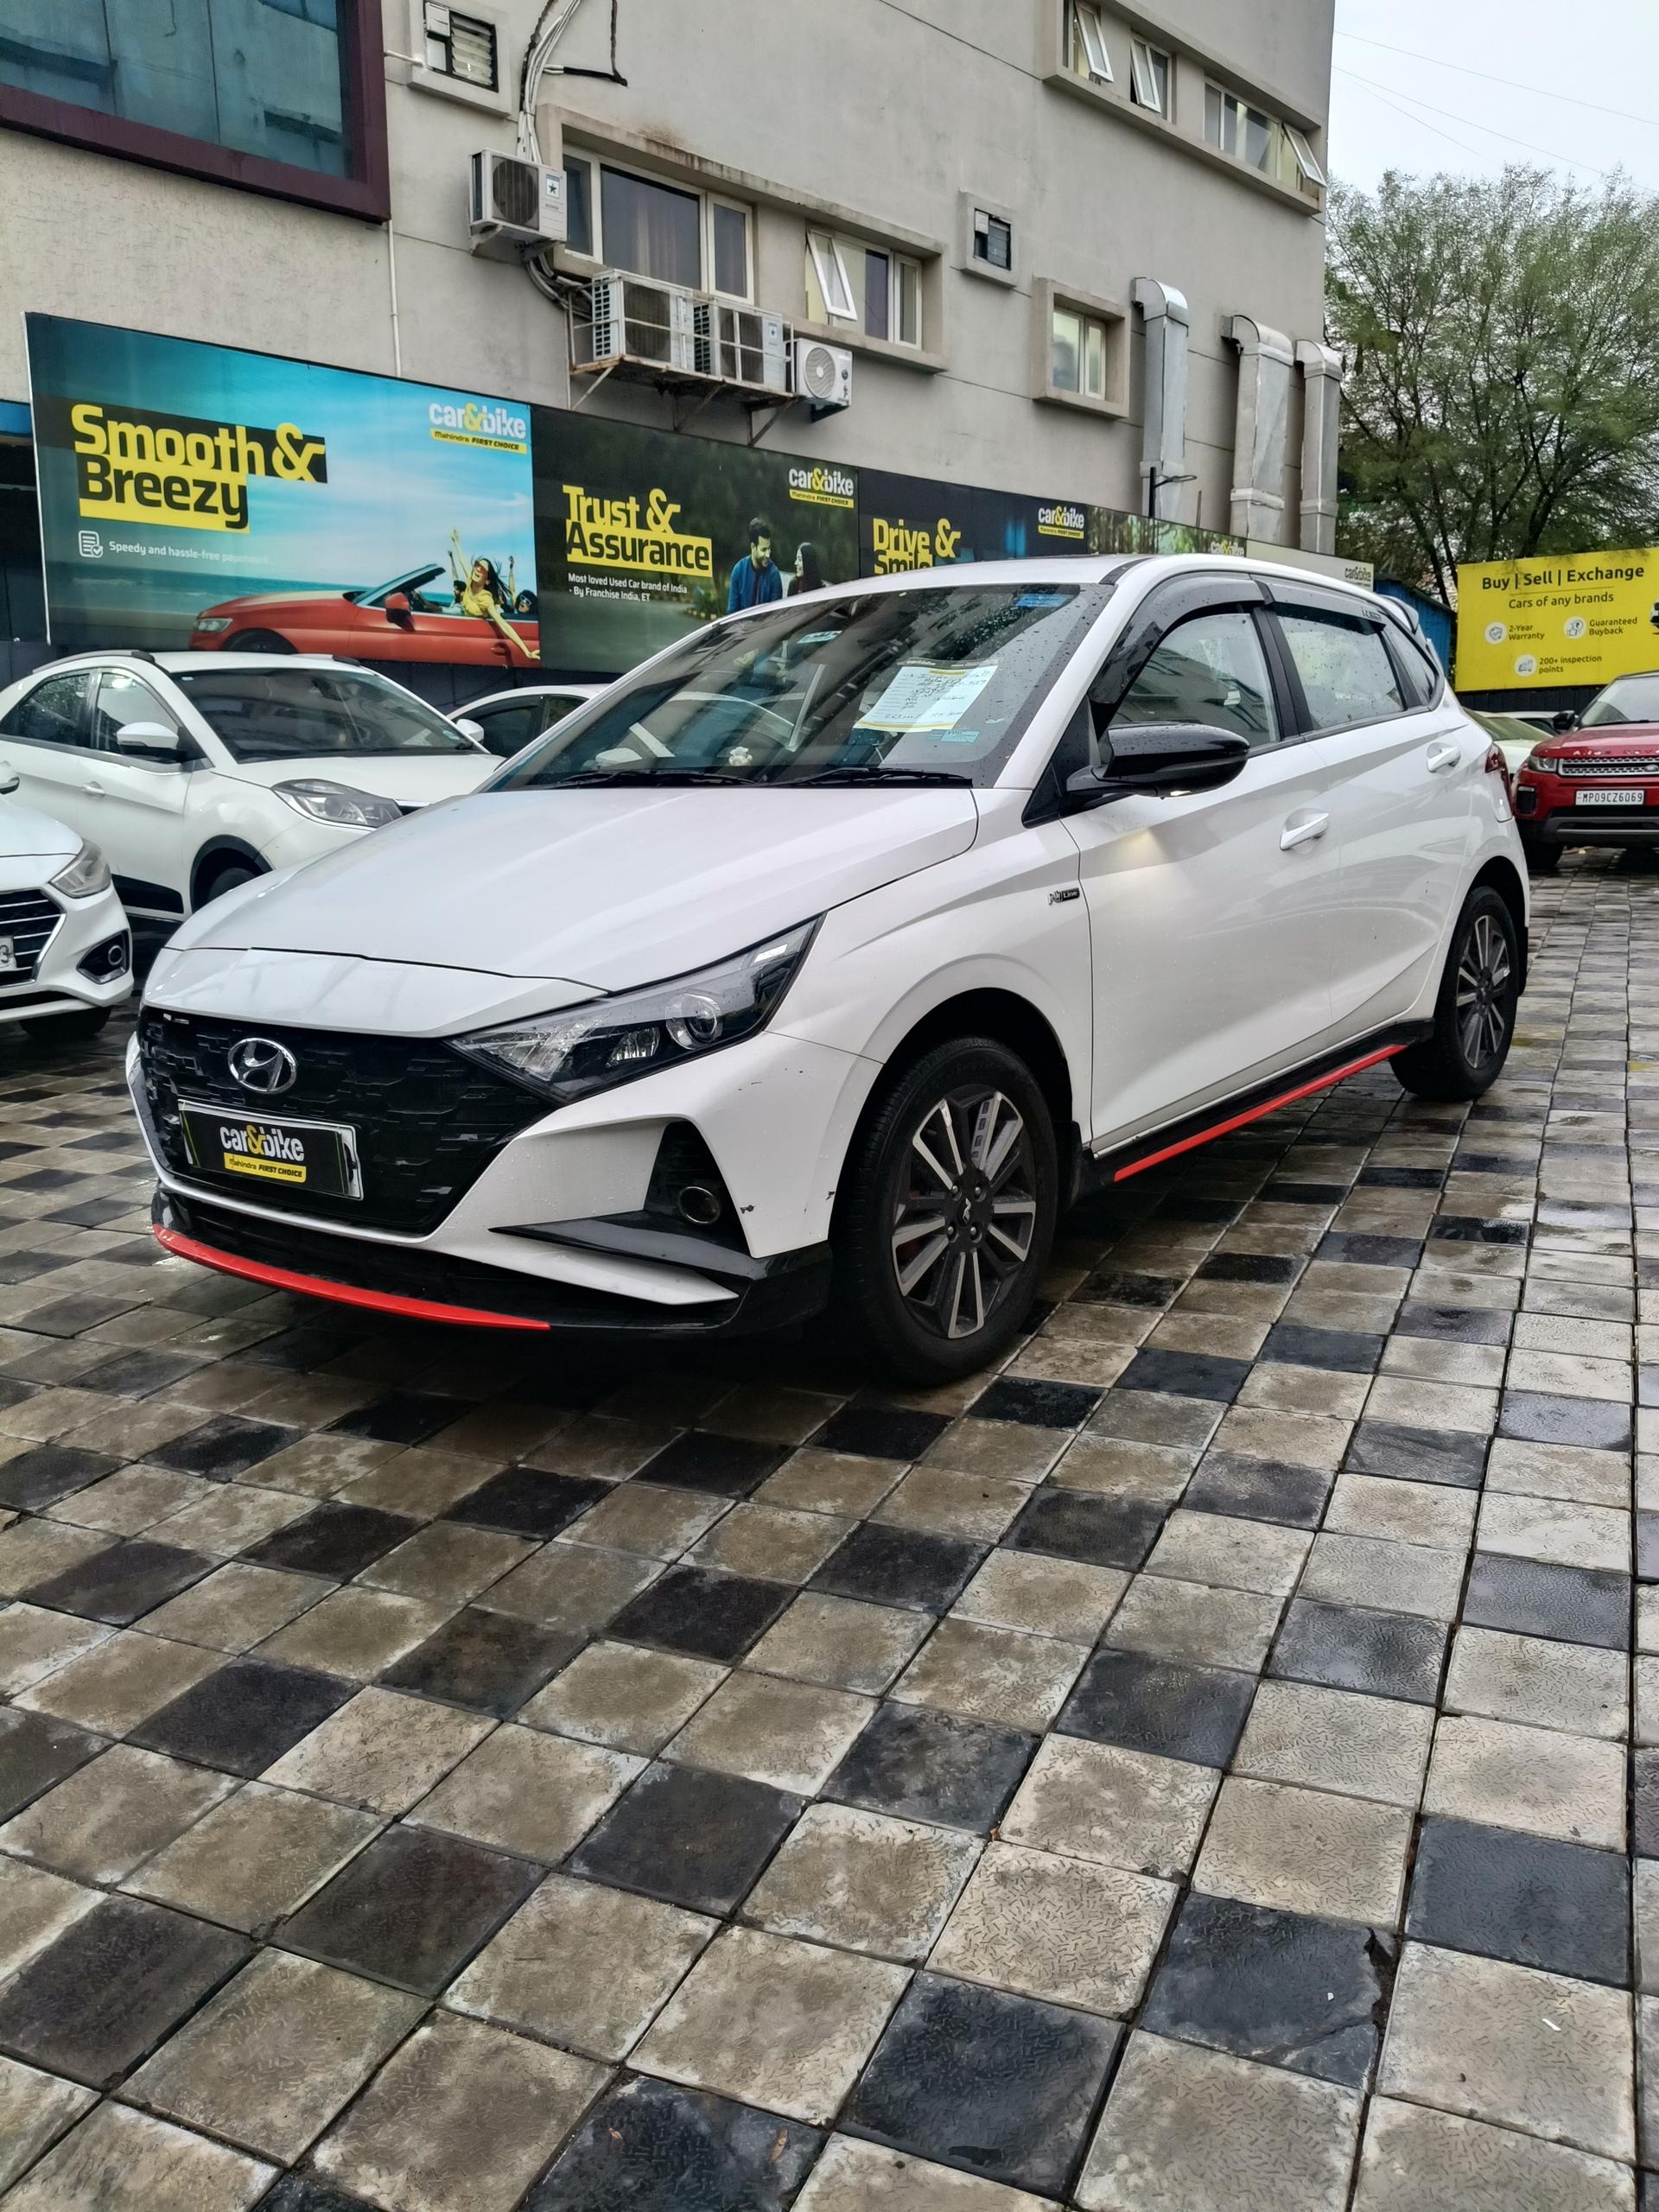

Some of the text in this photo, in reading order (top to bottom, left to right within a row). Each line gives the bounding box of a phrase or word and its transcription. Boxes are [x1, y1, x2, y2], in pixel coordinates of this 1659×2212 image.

[429, 403, 526, 439] car&bike
[70, 404, 326, 483] Smooth &
[472, 437, 493, 447] FIRST
[493, 441, 519, 451] CHOICE
[78, 452, 250, 530] Breezy
[789, 467, 854, 496] car&bike
[563, 484, 681, 534] Trust &
[1038, 505, 1085, 529] car&bike
[566, 521, 709, 571] Assurance
[873, 518, 961, 558] Drive &
[109, 541, 147, 556] Speedy
[148, 546, 167, 556] and
[168, 548, 220, 562] hassle-free
[568, 573, 687, 594] Most loved Used Car brand of India
[1482, 576, 1510, 591] Buy
[1523, 570, 1553, 587] Sell
[1567, 566, 1644, 582] Exchange
[573, 586, 584, 598] By
[585, 588, 620, 600] Franchise
[621, 591, 640, 602] India,
[641, 593, 651, 602] ET
[1509, 591, 1614, 609] Cars of any brands
[1589, 617, 1638, 627] Guaranteed
[1589, 626, 1624, 636] Buyback
[1509, 632, 1545, 640] Warranty
[1539, 665, 1564, 674] points
[1560, 655, 1602, 664] inspection
[1582, 792, 1643, 803] MP09CZ6069
[219, 1124, 305, 1162] car&bike
[258, 1164, 277, 1173] FIRST
[277, 1167, 303, 1178] CHOICE
